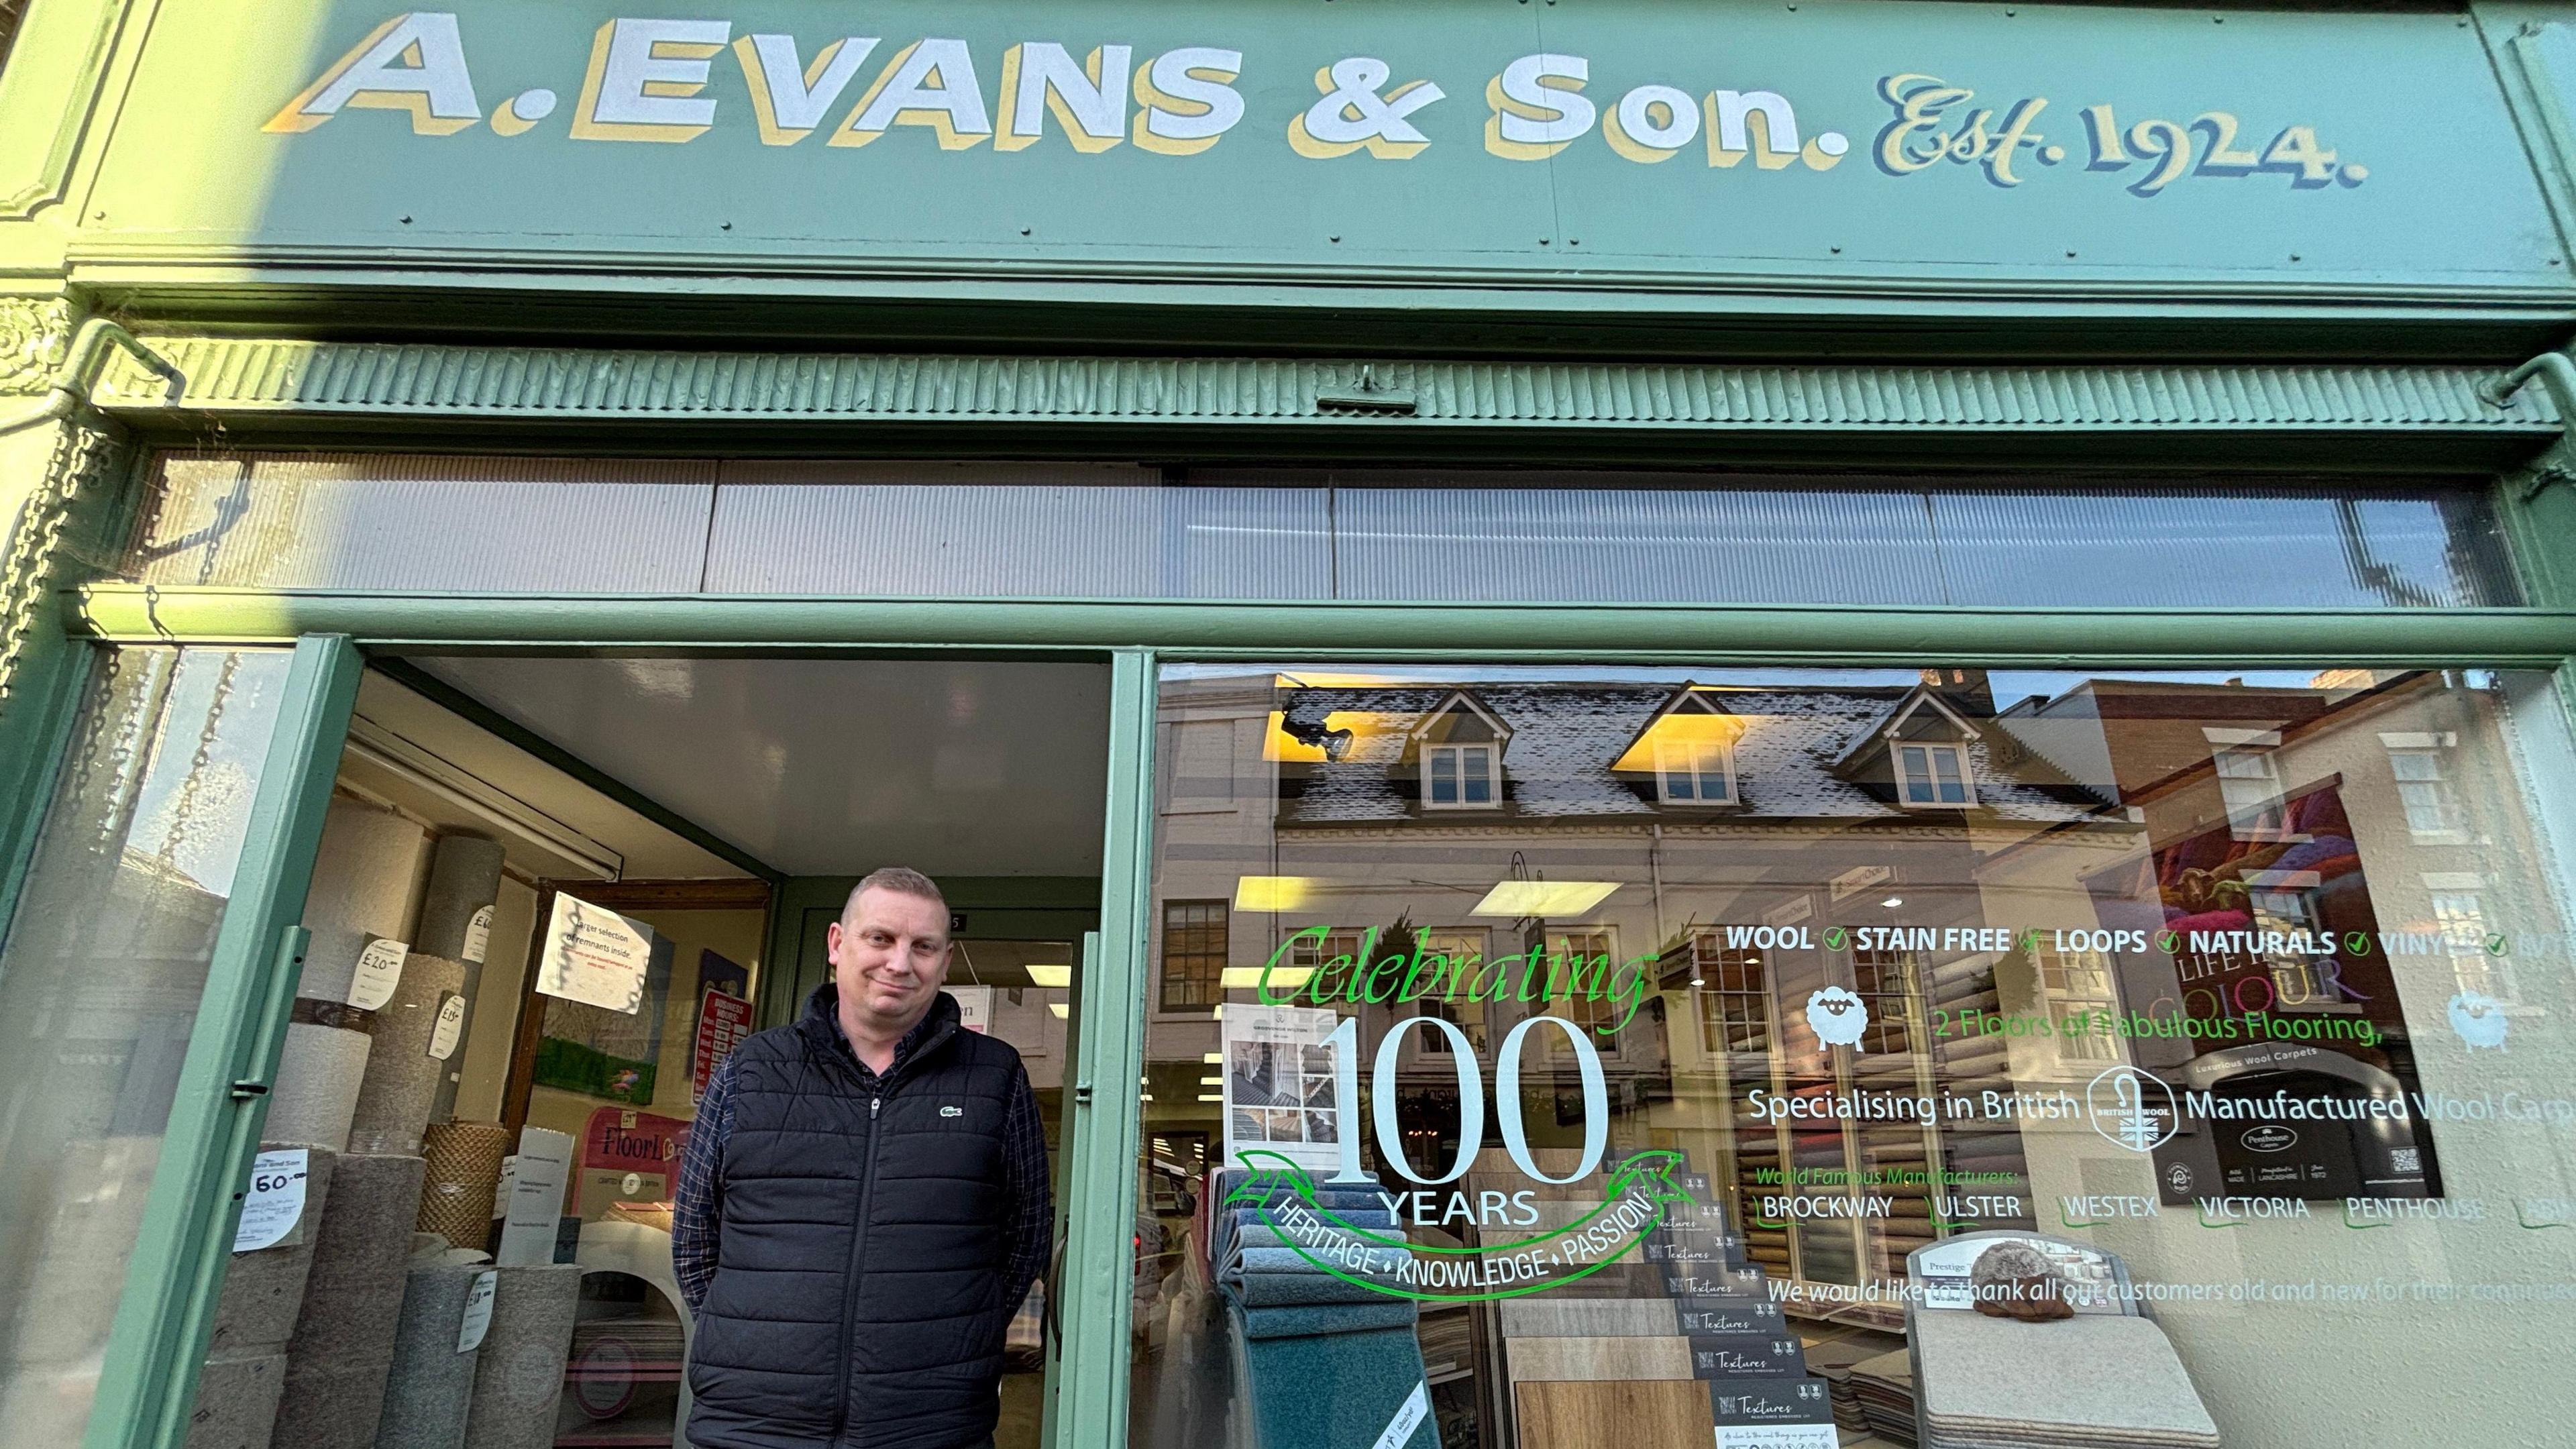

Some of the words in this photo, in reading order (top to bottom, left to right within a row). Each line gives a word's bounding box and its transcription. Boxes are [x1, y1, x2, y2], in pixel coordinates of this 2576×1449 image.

[1288, 56, 1446, 159] &
[1485, 54, 1849, 169] Son.
[1873, 72, 2065, 188] Est.
[2080, 104, 2369, 196] 1924.
[576, 935, 610, 953] remnants
[599, 928, 629, 943] selection
[1727, 926, 1815, 949] WOOL
[1856, 926, 1936, 951] STAIN
[1944, 928, 2010, 951] FREE
[2055, 930, 2147, 953] LOOPS
[2190, 930, 2337, 955] NATURALS
[1257, 925, 1660, 1035] Celebrating
[2149, 958, 2375, 1032] COLOUR
[1933, 1010, 1952, 1036] 2
[1960, 1008, 2052, 1038] Floors
[2100, 1009, 2238, 1039] Fabulous
[2245, 1011, 2383, 1047] Flooring,
[2196, 1058, 2243, 1073] Luxurious
[2245, 1054, 2271, 1065] Wool
[2274, 1047, 2318, 1062] Carpets
[1318, 1016, 1609, 1185] 100
[1748, 1089, 1937, 1126] Specialising
[1945, 1091, 1974, 1119] in
[1984, 1091, 2080, 1120] British
[2186, 1091, 2408, 1120] Manufactured
[2411, 1091, 2495, 1120] Wool
[2142, 1108, 2171, 1116] WOOL
[2247, 1134, 2289, 1144] Penthouse
[1756, 1167, 1809, 1185] World
[1813, 1167, 1882, 1185] Famous
[1886, 1167, 2019, 1185] Manufacturers:
[1377, 1190, 1540, 1226] YEARS
[1764, 1196, 1893, 1218] BROCKWAY
[1936, 1196, 2022, 1218] ULSTER
[2064, 1196, 2159, 1218] WESTEX
[2200, 1197, 2311, 1218] VICTORIA
[2347, 1197, 2486, 1219] PENTHOUSE
[1273, 1195, 1380, 1276] HERITAGE
[1395, 1248, 1550, 1287] KNOWLEDGE
[1561, 1191, 1655, 1267] PASSION
[1664, 1244, 1711, 1260] Textures
[1929, 1262, 1966, 1272] Prestige
[1685, 1277, 1733, 1294] Textures
[1767, 1279, 1803, 1302] We
[1808, 1279, 1879, 1302] would
[1886, 1279, 1923, 1301] like
[1929, 1282, 1951, 1301] to
[1960, 1277, 2025, 1301] thank
[2030, 1277, 2056, 1301] all
[2106, 1283, 2223, 1301] customers
[2229, 1279, 2265, 1301] old
[2271, 1279, 2314, 1301] and
[2322, 1284, 2369, 1301] new
[2373, 1277, 2405, 1301] for
[1700, 1313, 1752, 1330] Textures
[1715, 1350, 1768, 1369] Textures
[1737, 1395, 1793, 1415] Textures
